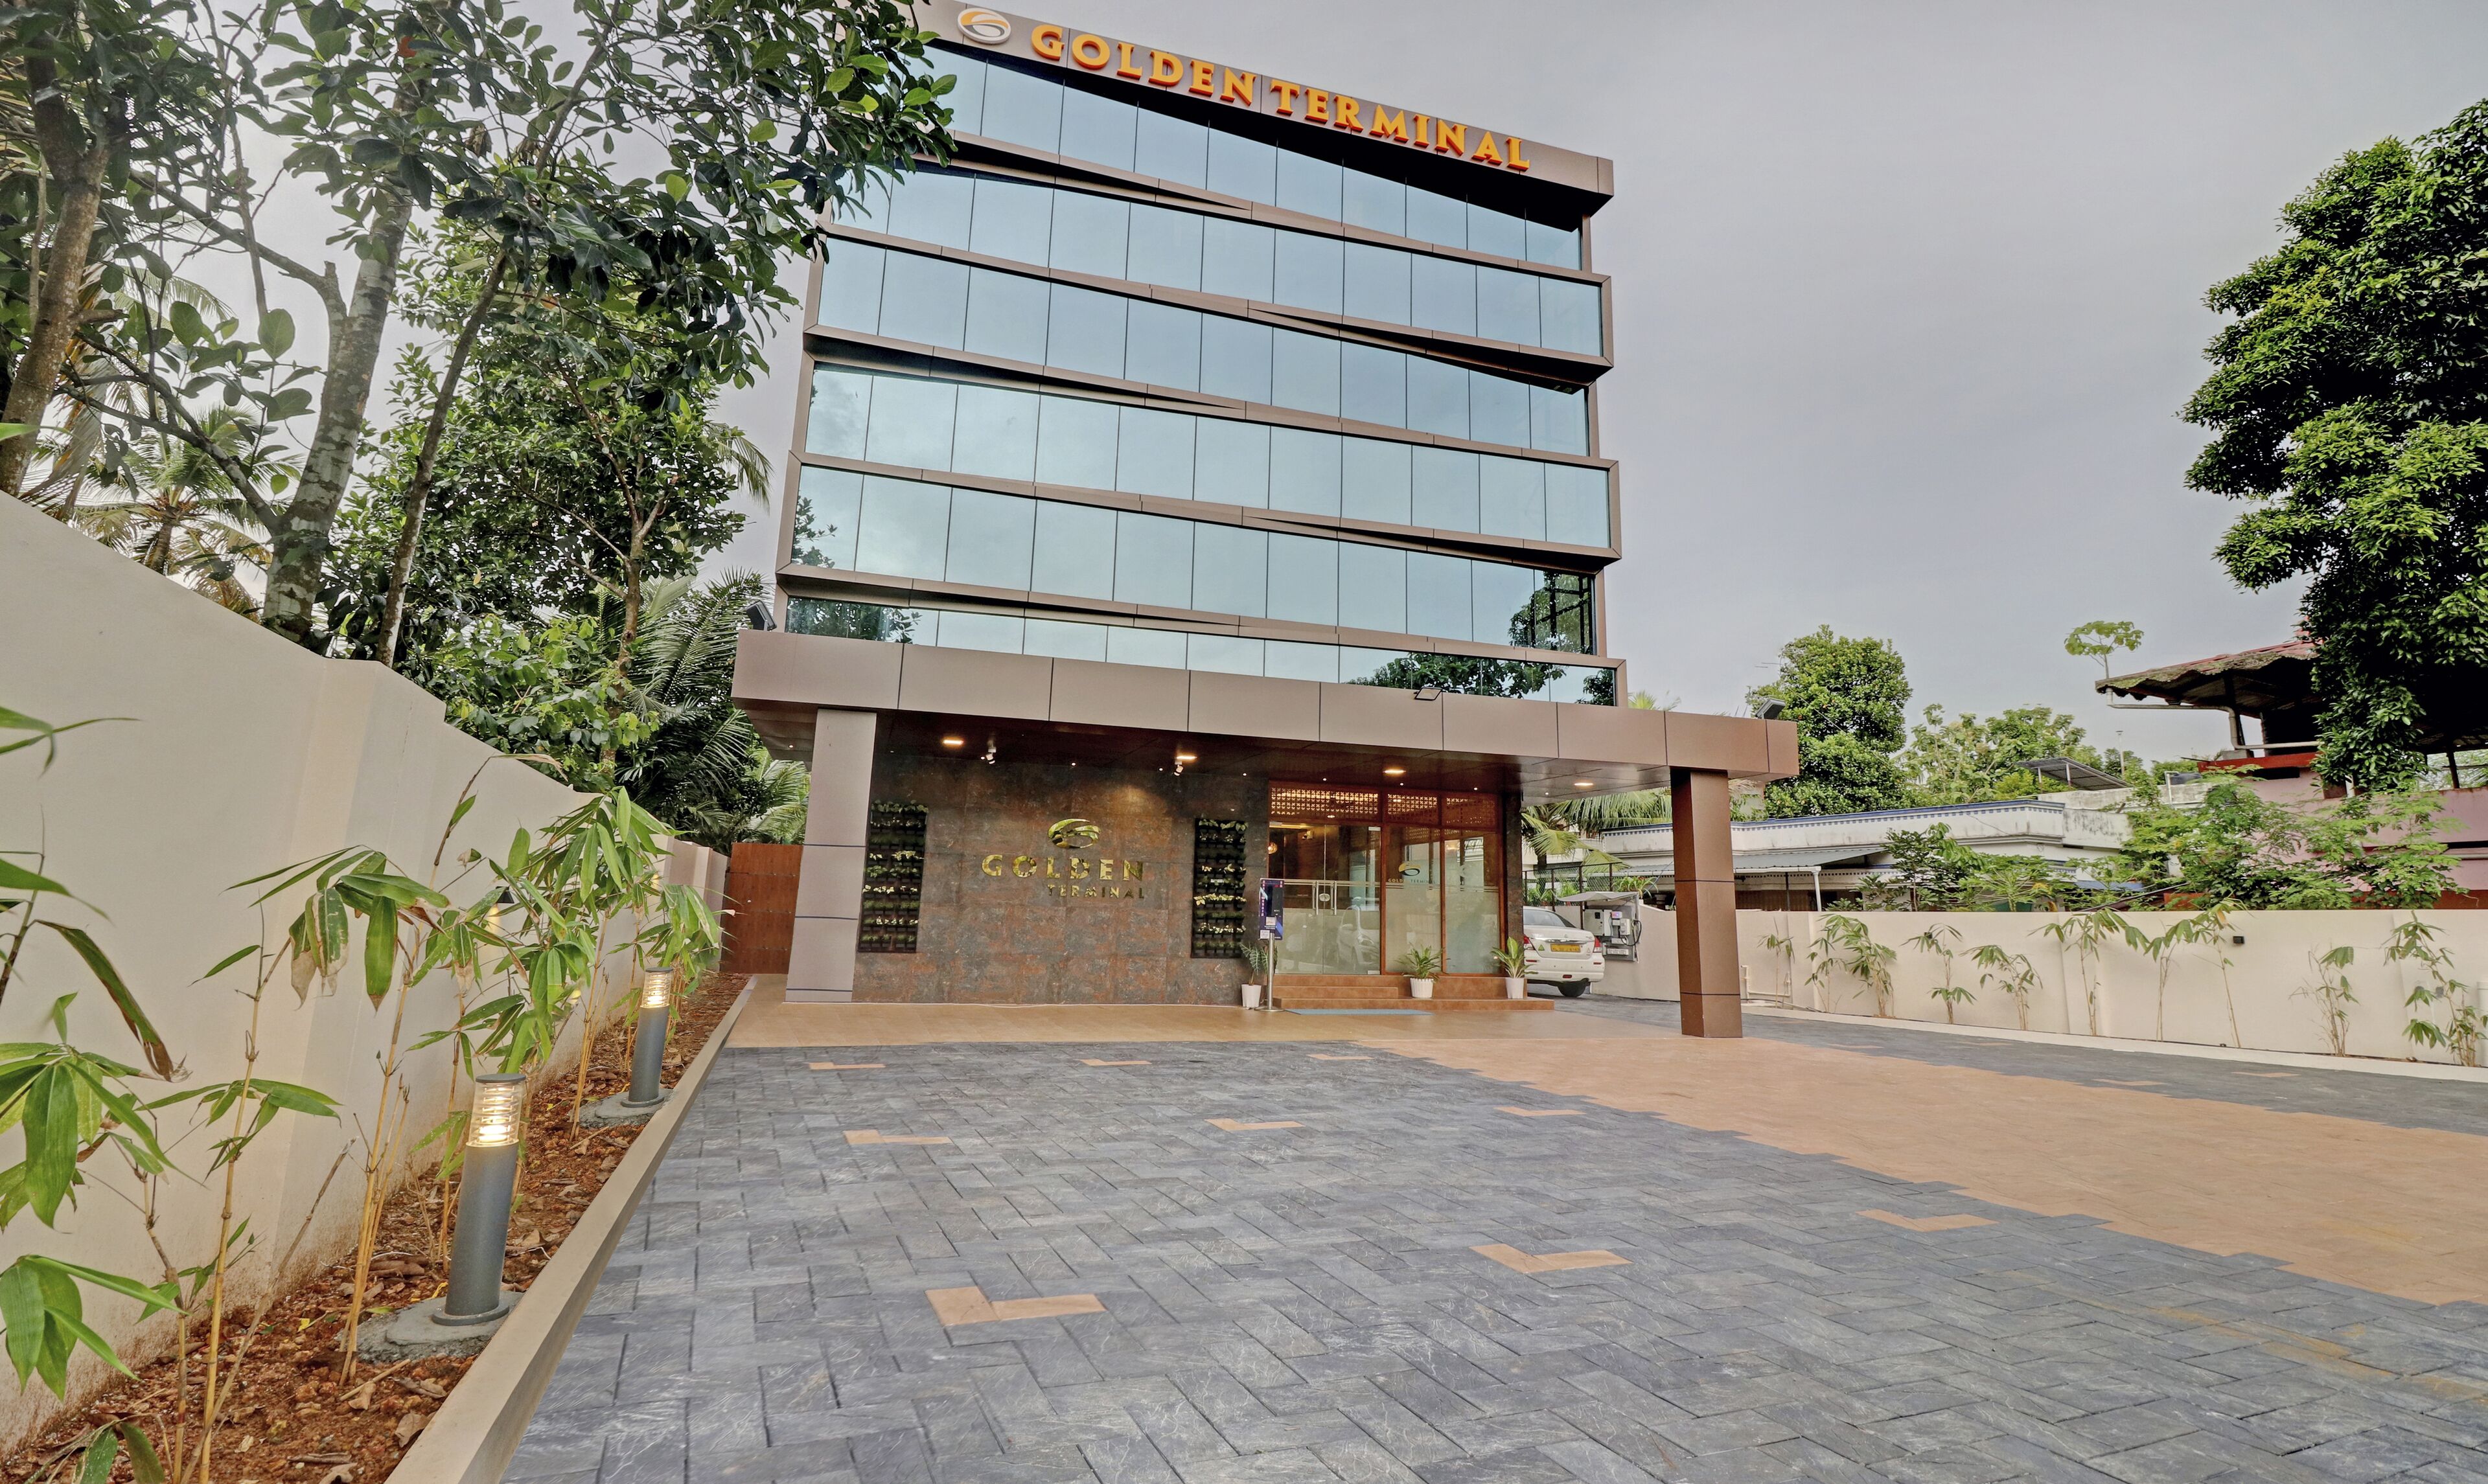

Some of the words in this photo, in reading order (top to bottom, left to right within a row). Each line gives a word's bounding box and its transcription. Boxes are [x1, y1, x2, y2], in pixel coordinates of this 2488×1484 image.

[1031, 24, 1256, 106] GOLDEN
[1271, 79, 1530, 171] TERMINAL
[982, 854, 1144, 881] GOLDEN
[1047, 884, 1145, 898] TERMINAL
